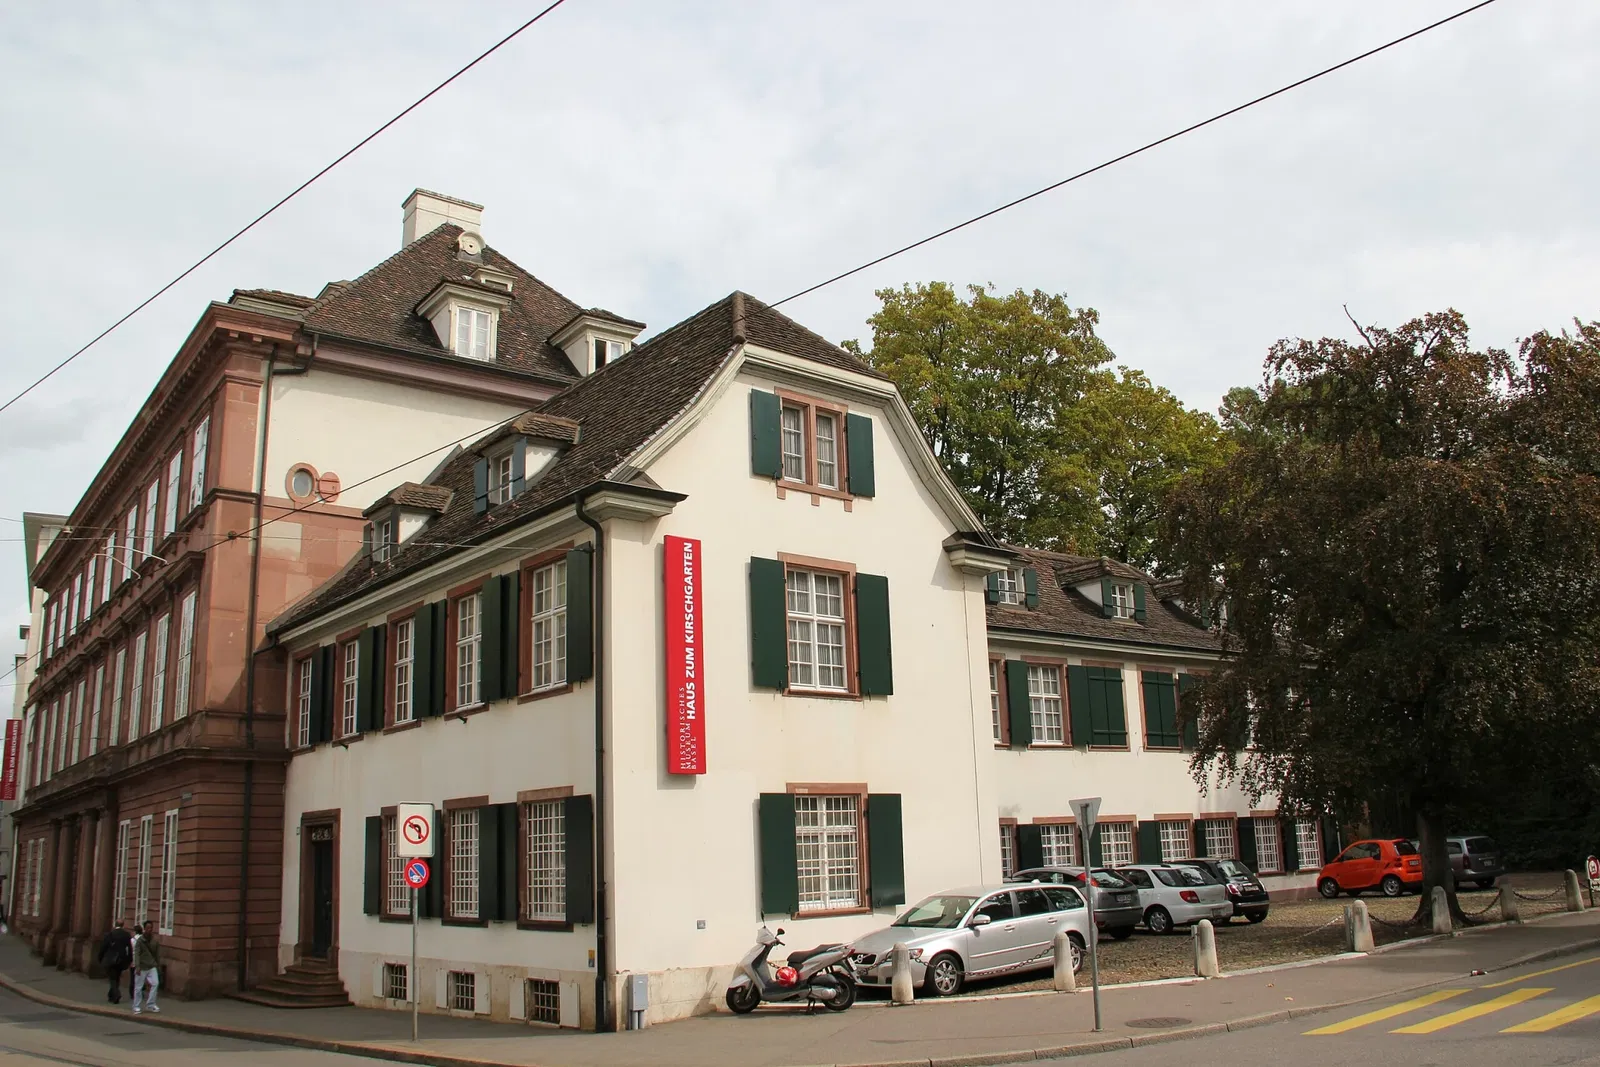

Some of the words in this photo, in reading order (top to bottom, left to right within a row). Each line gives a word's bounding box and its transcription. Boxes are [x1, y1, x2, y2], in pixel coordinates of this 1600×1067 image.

[683, 542, 694, 643] KIRSCHGARTEN
[685, 647, 695, 679] ZUM
[686, 682, 696, 720] HAUS
